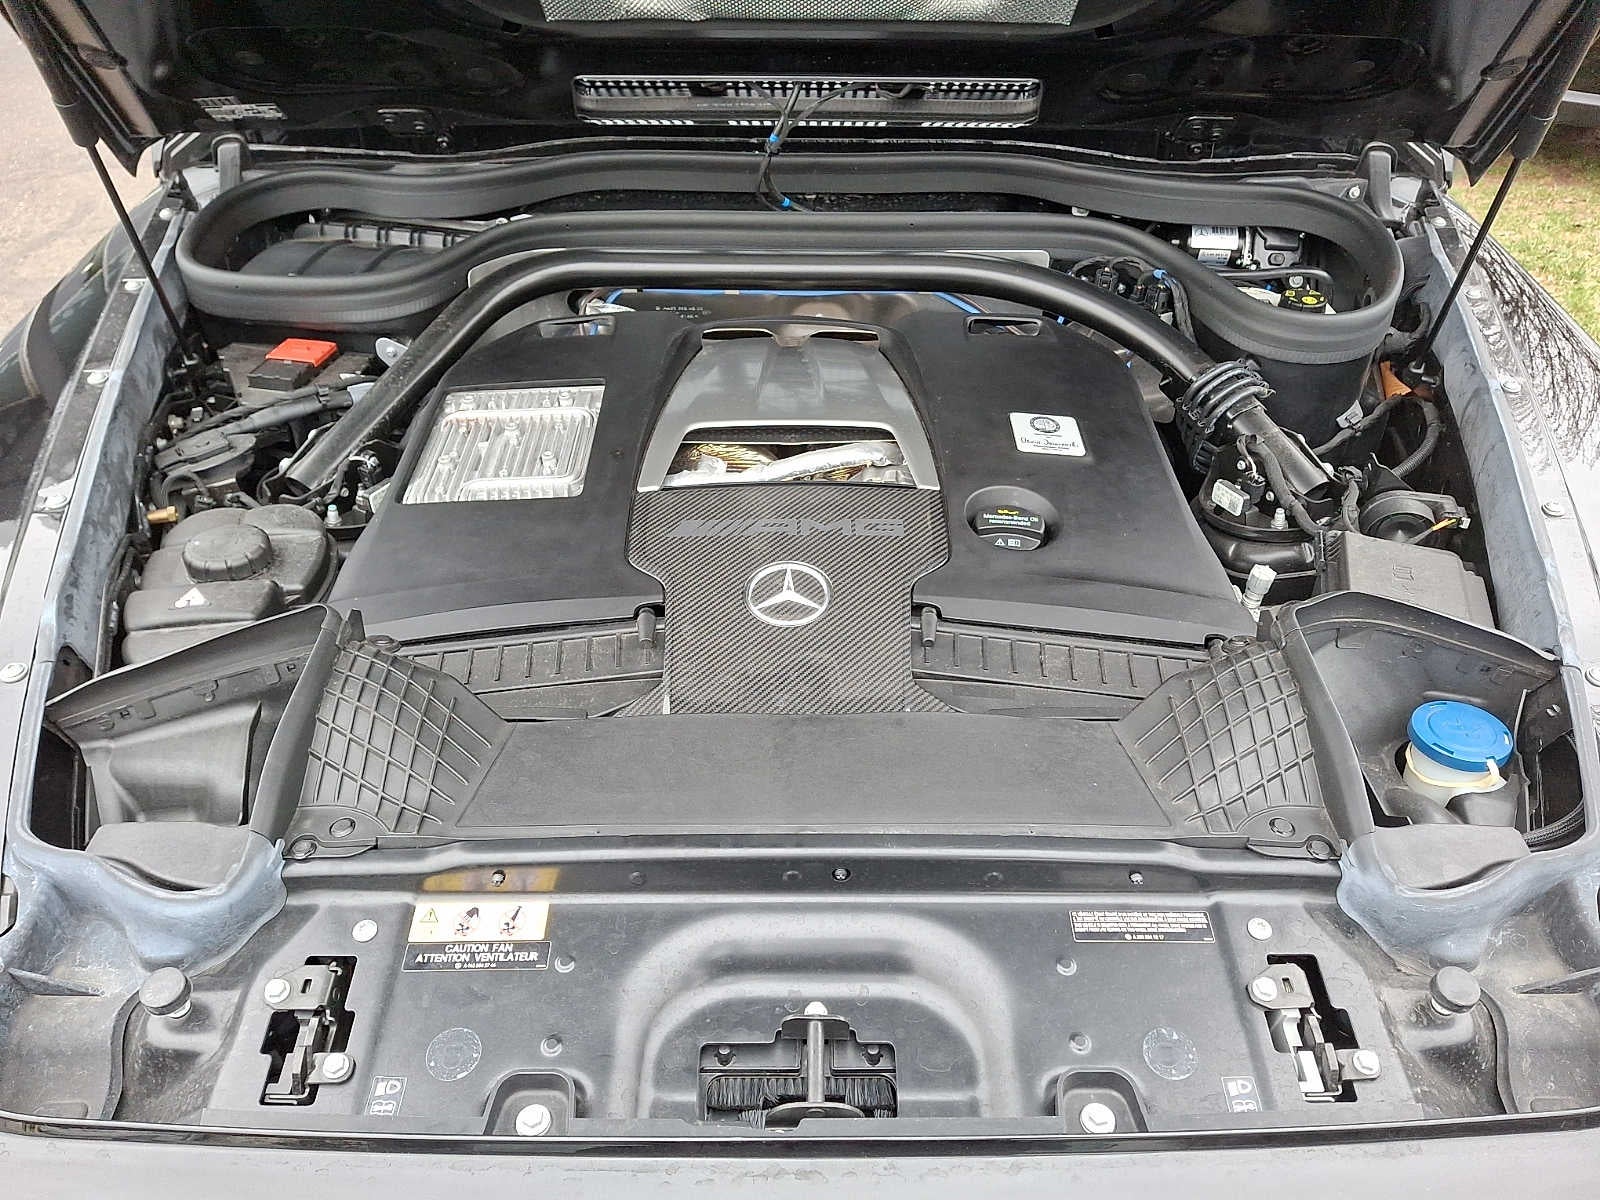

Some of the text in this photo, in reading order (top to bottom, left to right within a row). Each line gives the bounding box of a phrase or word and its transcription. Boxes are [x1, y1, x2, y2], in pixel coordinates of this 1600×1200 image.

[445, 943, 514, 953] CAUTION FAN
[415, 952, 539, 963] ATTENTION VENTILATEUR
